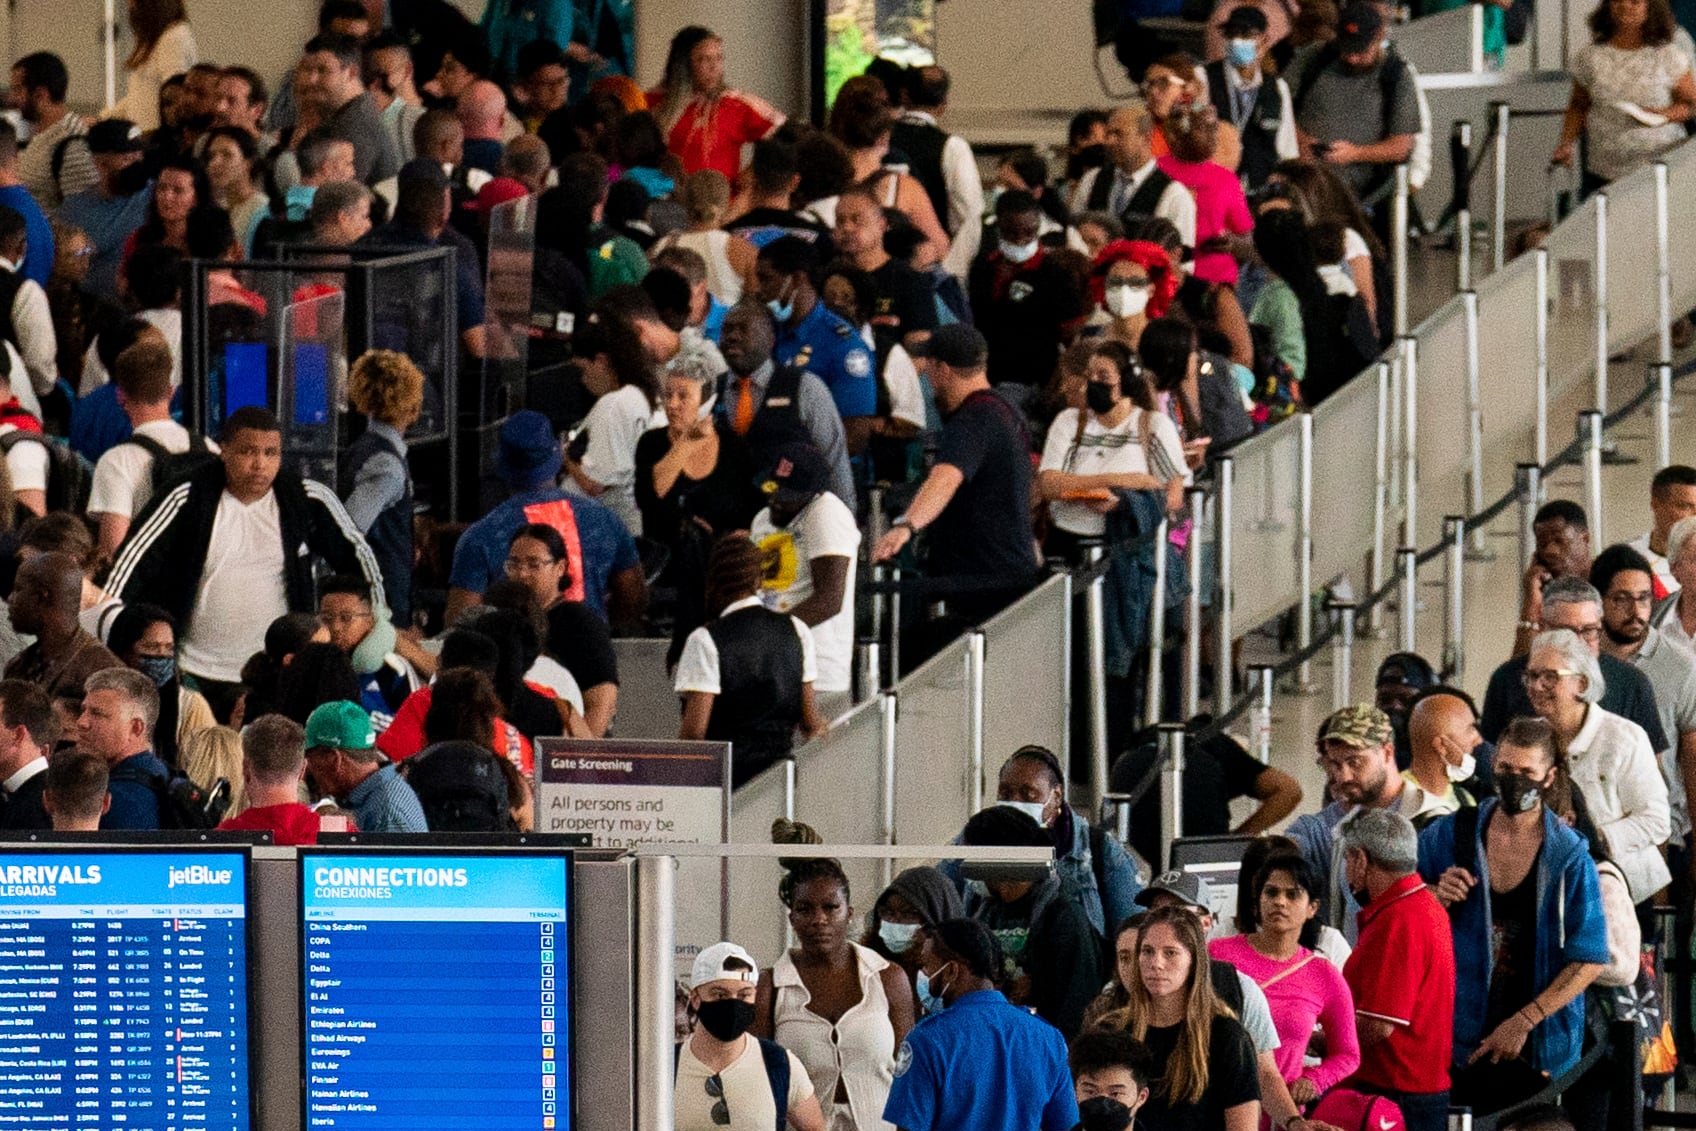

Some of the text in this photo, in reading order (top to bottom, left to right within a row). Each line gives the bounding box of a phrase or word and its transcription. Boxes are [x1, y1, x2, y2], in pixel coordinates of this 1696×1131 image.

[551, 758, 633, 772] Gate Screening
[551, 796, 663, 812] All persons and
[551, 816, 674, 832] property may be
[168, 866, 232, 888] jetBlue
[314, 868, 468, 887] CONNECTIONS
[0, 885, 56, 896] LEGADAS
[314, 887, 392, 899] CONEXIONES
[309, 937, 331, 945] COPA
[309, 951, 330, 959] Delta
[310, 965, 331, 973] Delta
[347, 1020, 377, 1028] Airlines
[336, 1034, 366, 1043] Airways
[339, 1090, 369, 1098] Airlines
[347, 1104, 377, 1112] Airlines
